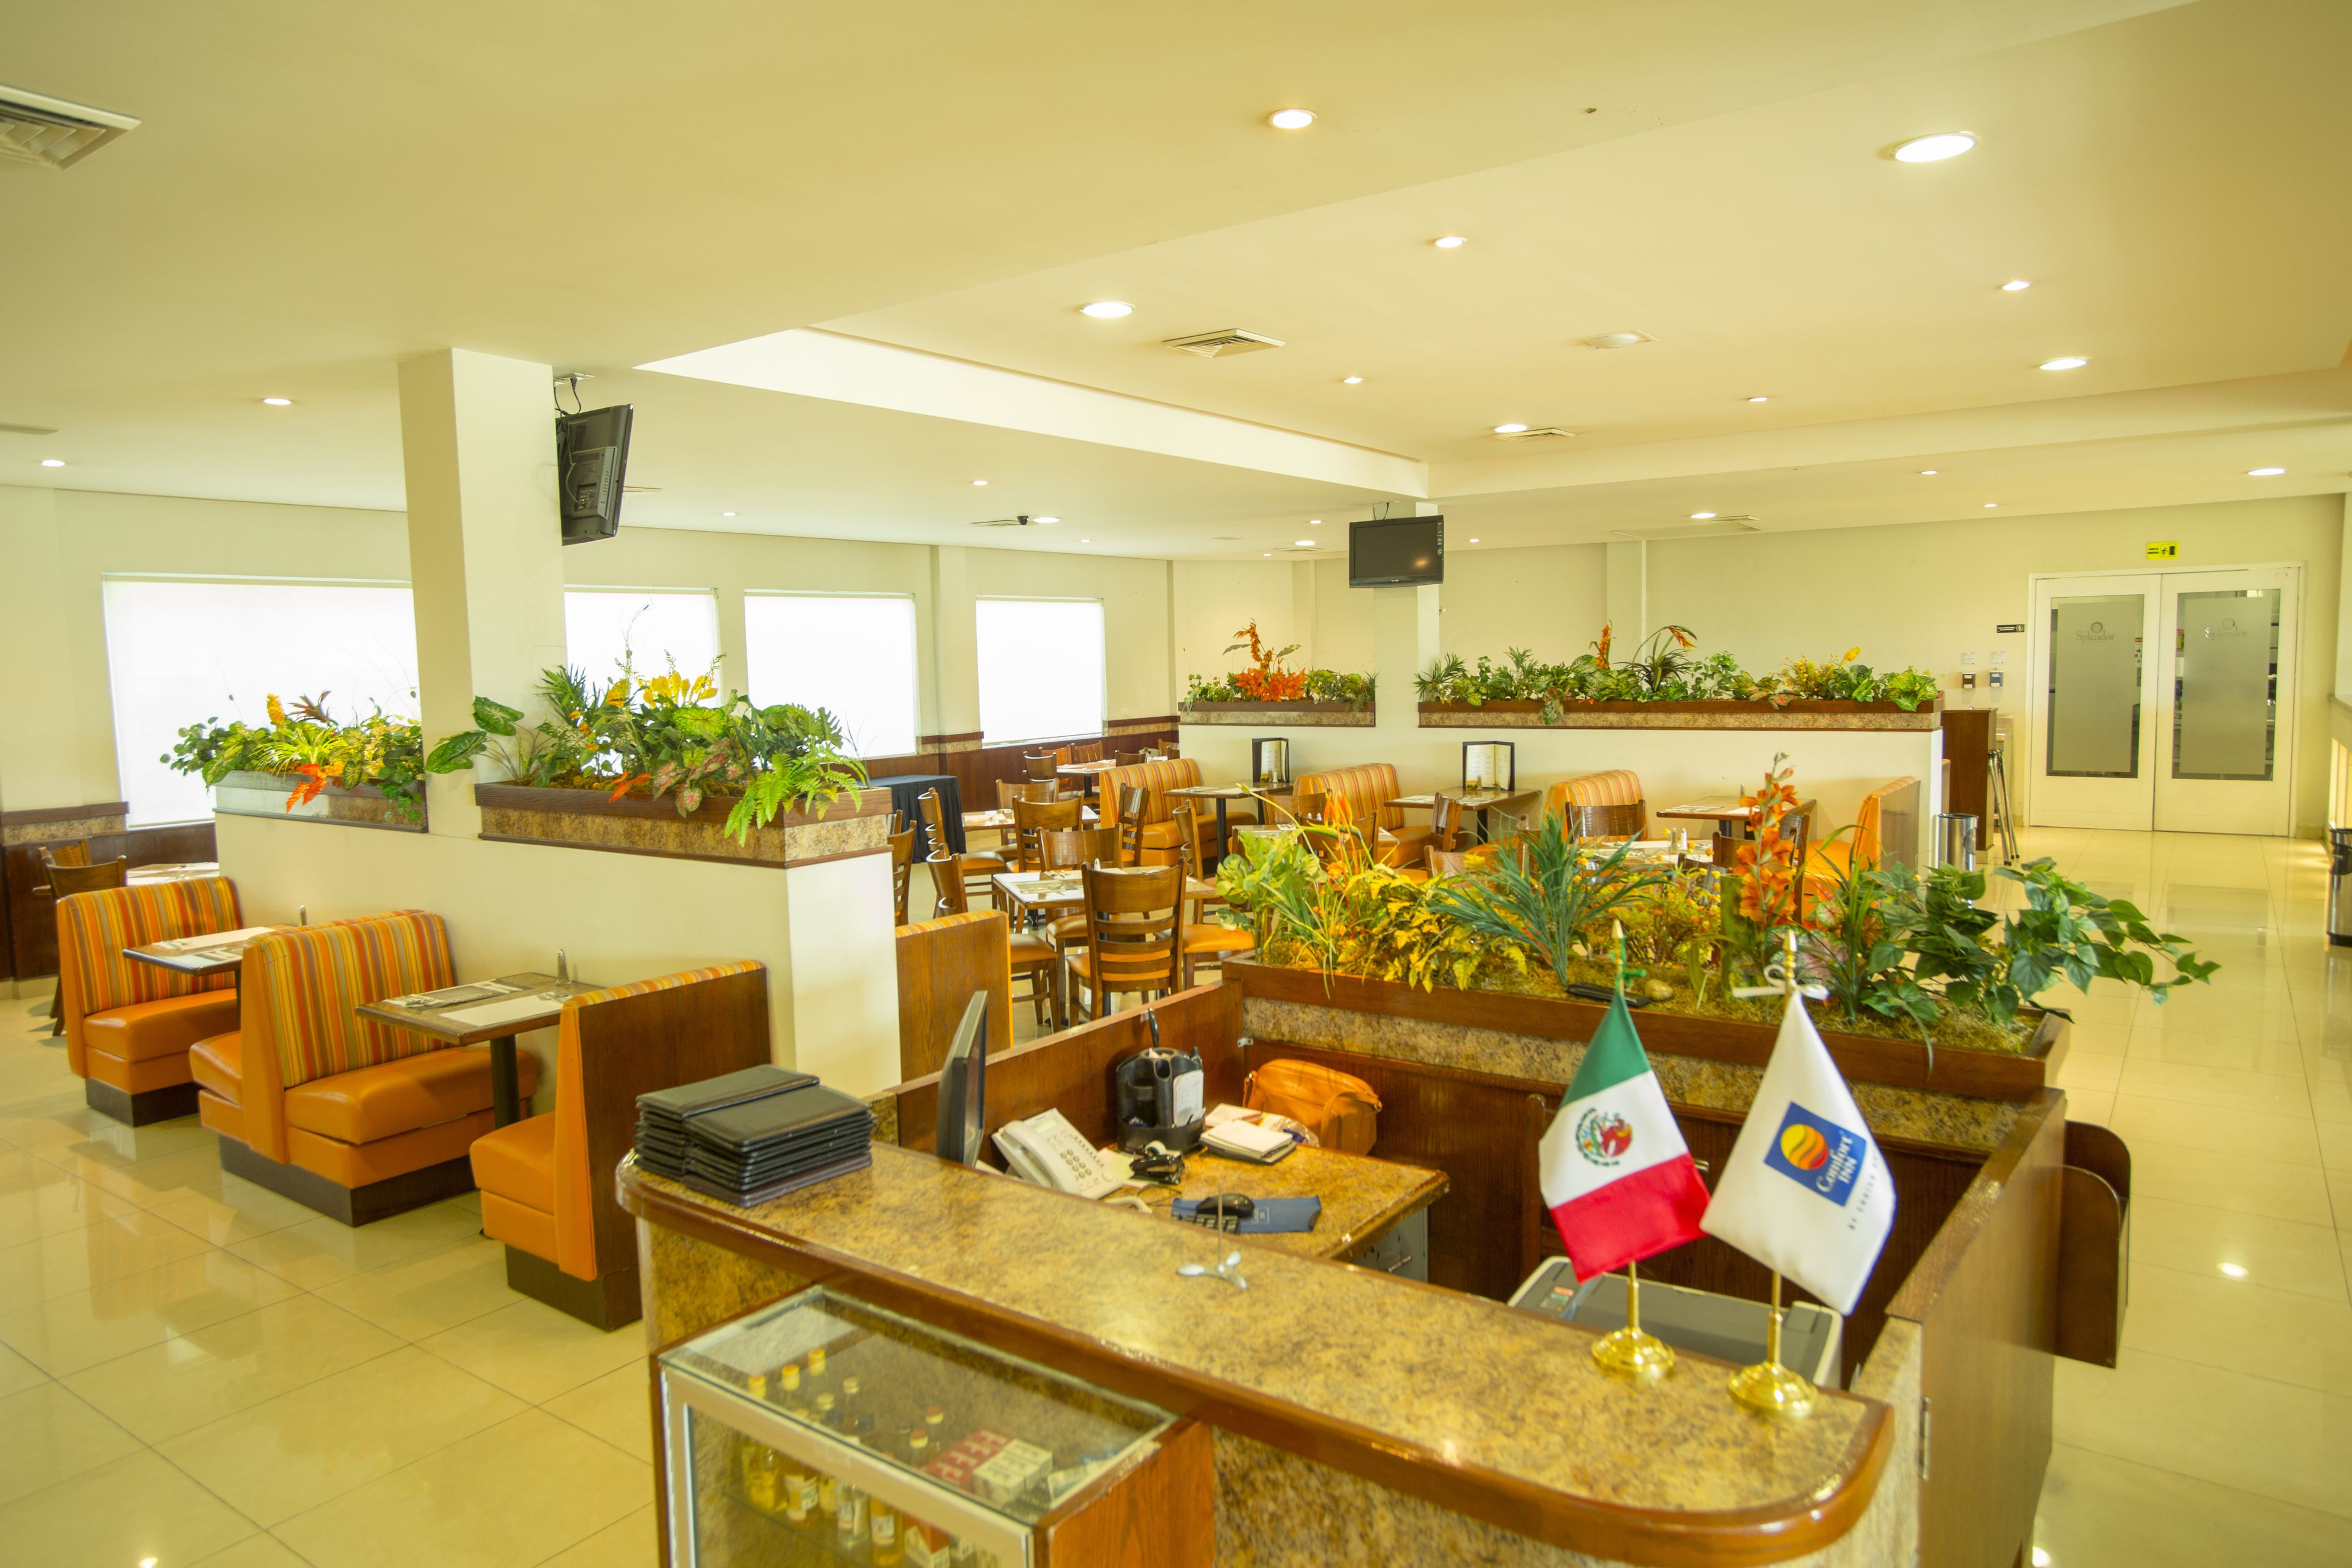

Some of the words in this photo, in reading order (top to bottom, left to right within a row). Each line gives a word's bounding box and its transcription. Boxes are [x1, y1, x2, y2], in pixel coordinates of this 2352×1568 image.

[2076, 630, 2116, 643] Splendor
[1816, 1136, 1853, 1192] Comfort
[1838, 1155, 1858, 1185] INN
